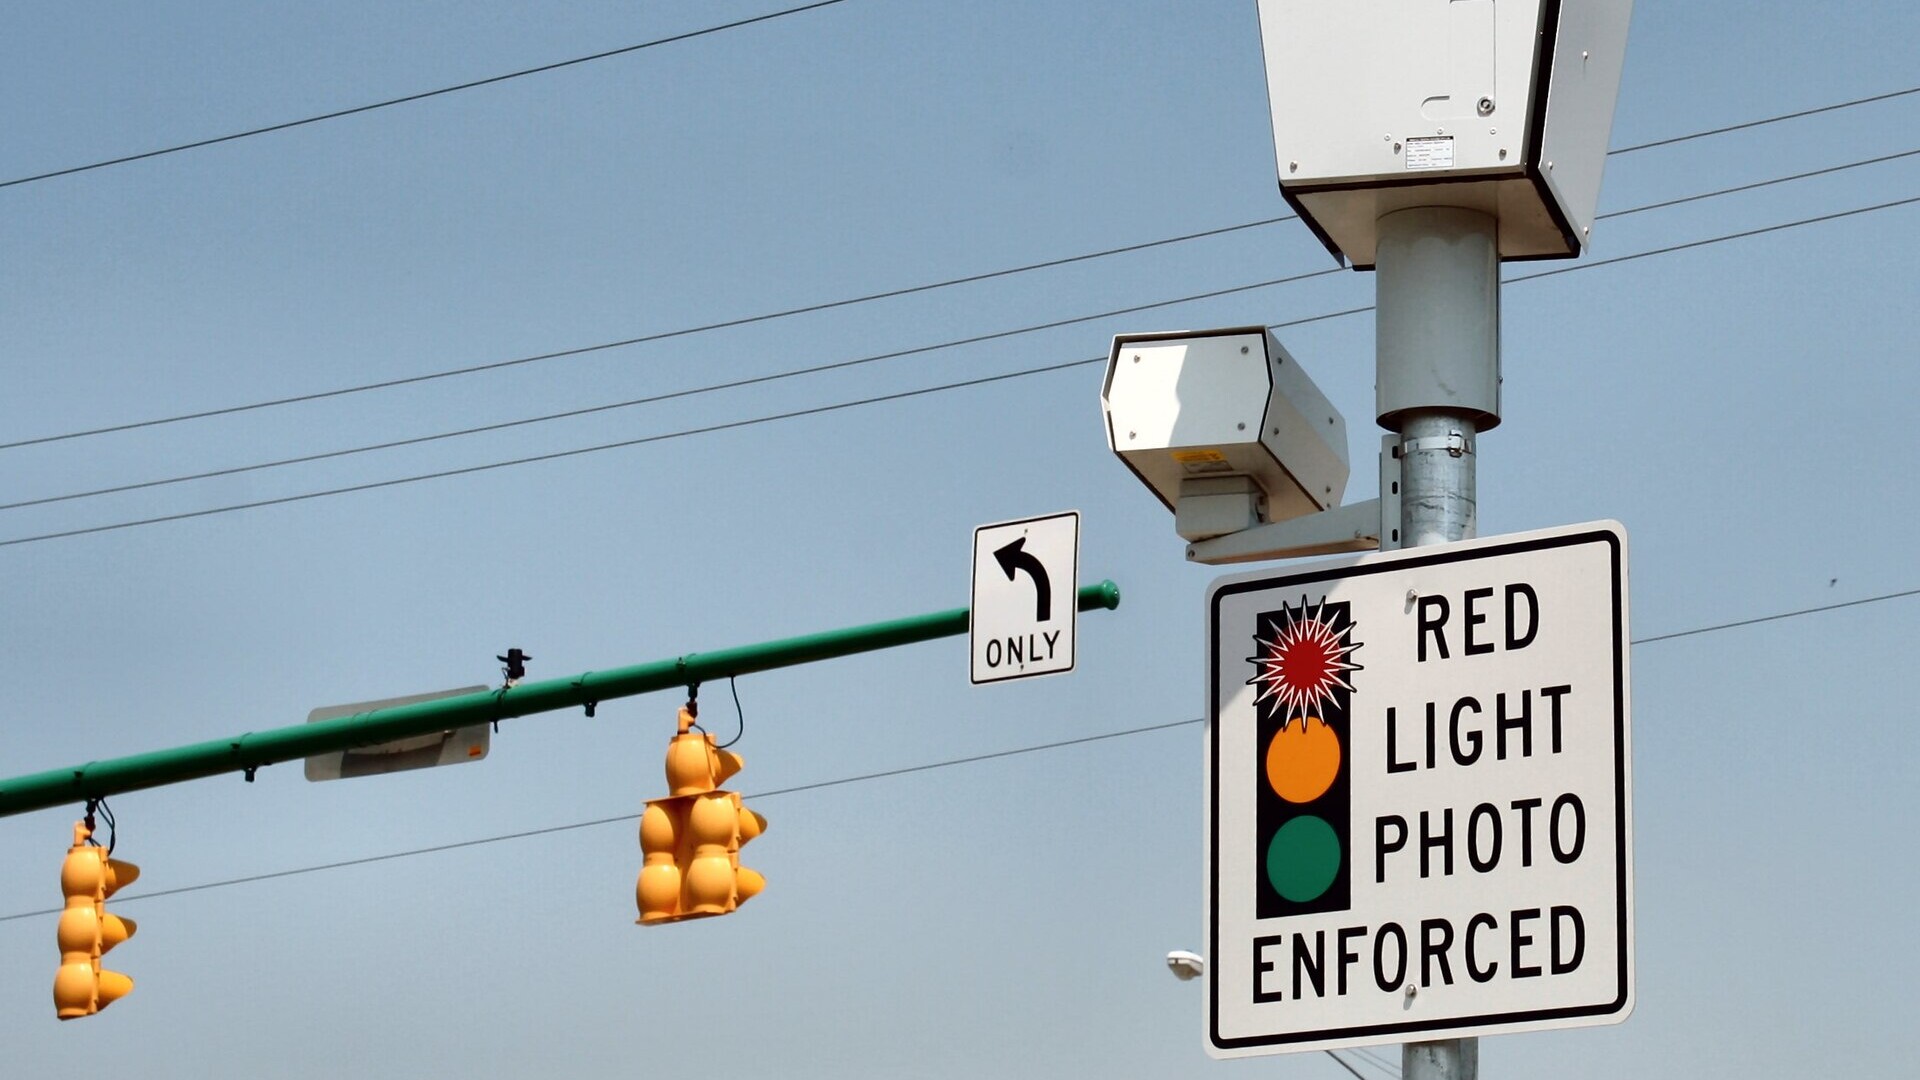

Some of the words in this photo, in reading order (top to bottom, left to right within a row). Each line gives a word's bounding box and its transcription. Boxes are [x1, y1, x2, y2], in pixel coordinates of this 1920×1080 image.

[986, 630, 1060, 667] ONLY
[1417, 583, 1540, 662] RED
[1386, 684, 1572, 774] LIGHT
[1375, 792, 1586, 883] PHOTO
[1253, 905, 1586, 1004] ENFORCED
